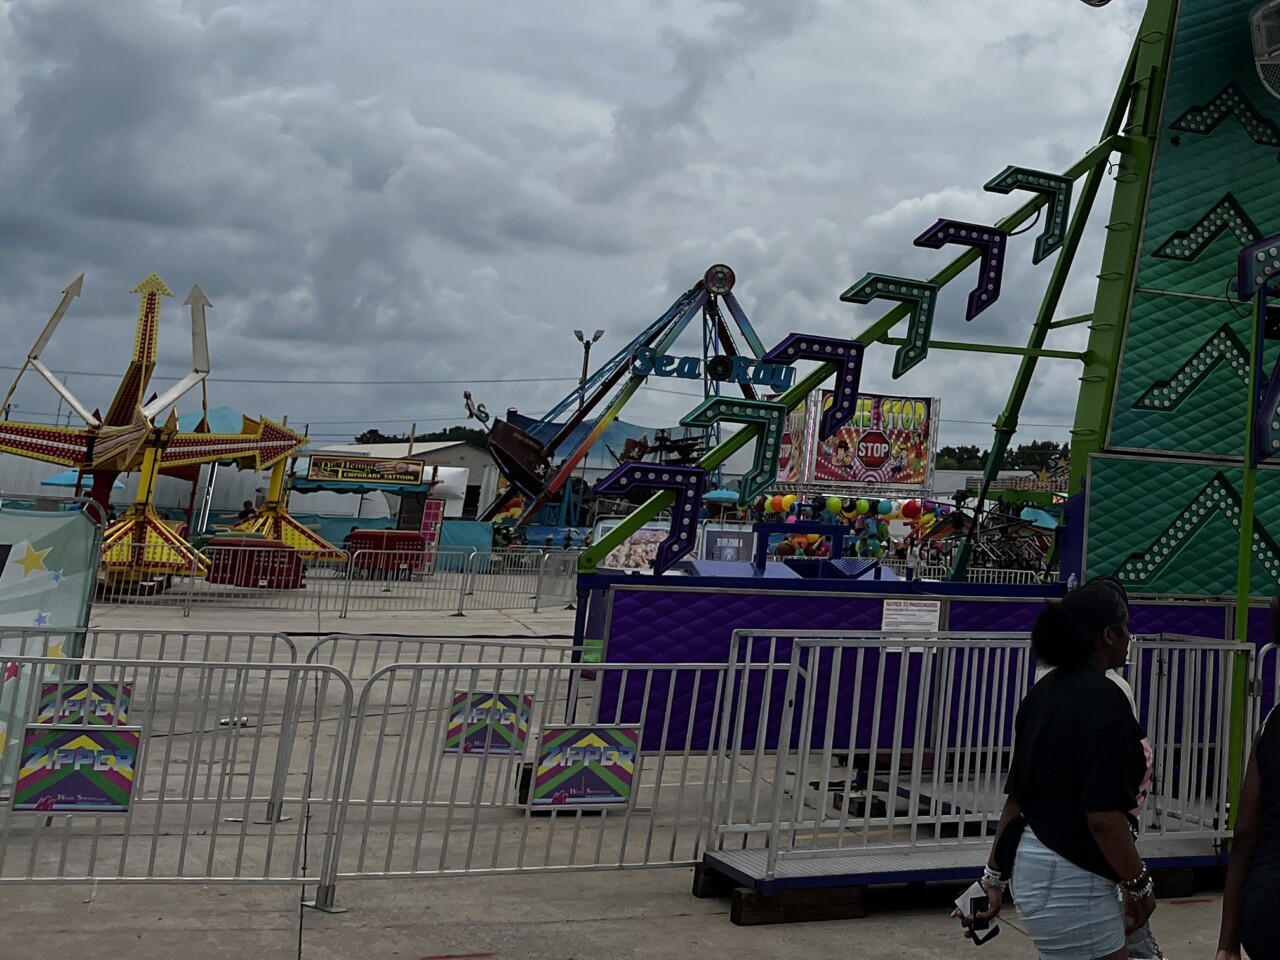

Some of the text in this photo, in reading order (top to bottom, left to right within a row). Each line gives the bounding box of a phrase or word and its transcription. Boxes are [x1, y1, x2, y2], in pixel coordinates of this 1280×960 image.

[631, 346, 797, 393] Sea Ray
[880, 398, 927, 431] STOP
[858, 442, 889, 458] STOP
[337, 467, 415, 481] TEMPORARY TATTOOS
[25, 747, 135, 771] ZIPPER
[543, 745, 636, 767] ZIPPER
